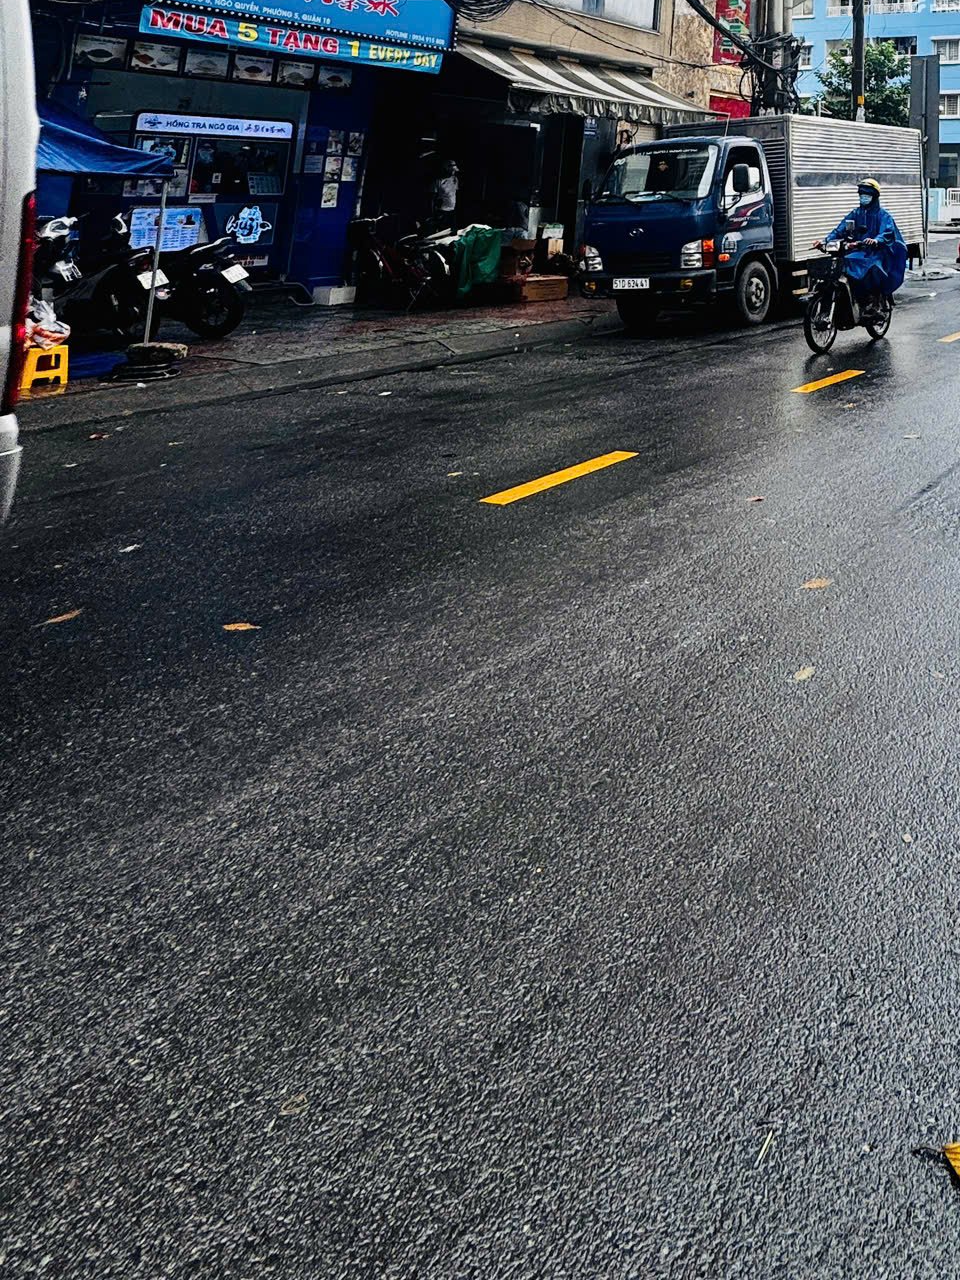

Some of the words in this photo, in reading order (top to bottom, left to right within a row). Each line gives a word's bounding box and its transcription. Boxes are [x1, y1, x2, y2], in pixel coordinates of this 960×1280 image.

[150, 8, 230, 39] MUA
[237, 22, 259, 42] 5
[266, 28, 339, 54] TẶNG
[348, 40, 360, 57] 1
[368, 44, 411, 65] EVERY
[413, 52, 439, 68] DAY
